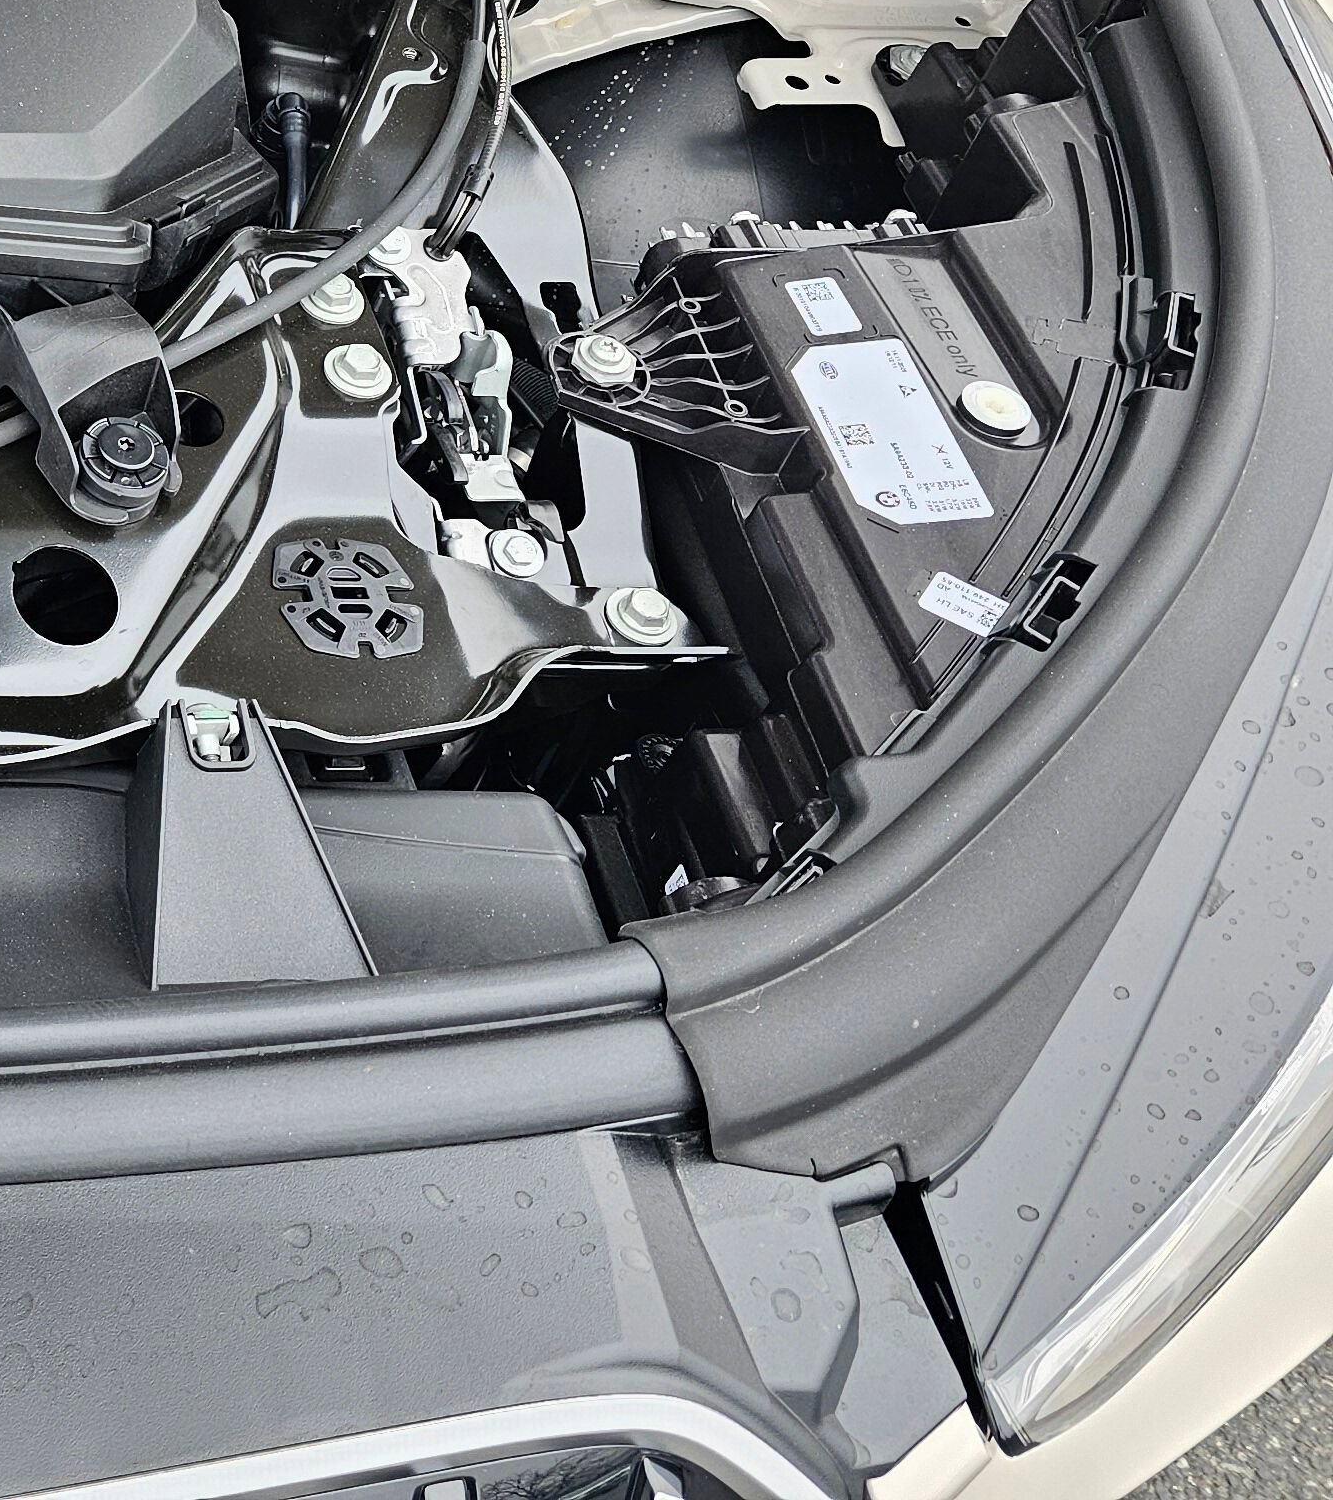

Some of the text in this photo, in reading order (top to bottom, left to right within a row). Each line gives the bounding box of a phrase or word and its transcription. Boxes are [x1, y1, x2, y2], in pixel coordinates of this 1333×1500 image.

[920, 306, 958, 341] ECE
[946, 343, 977, 376] only
[940, 457, 953, 468] 12V
[935, 595, 951, 608] LH
[951, 603, 975, 619] SAE
